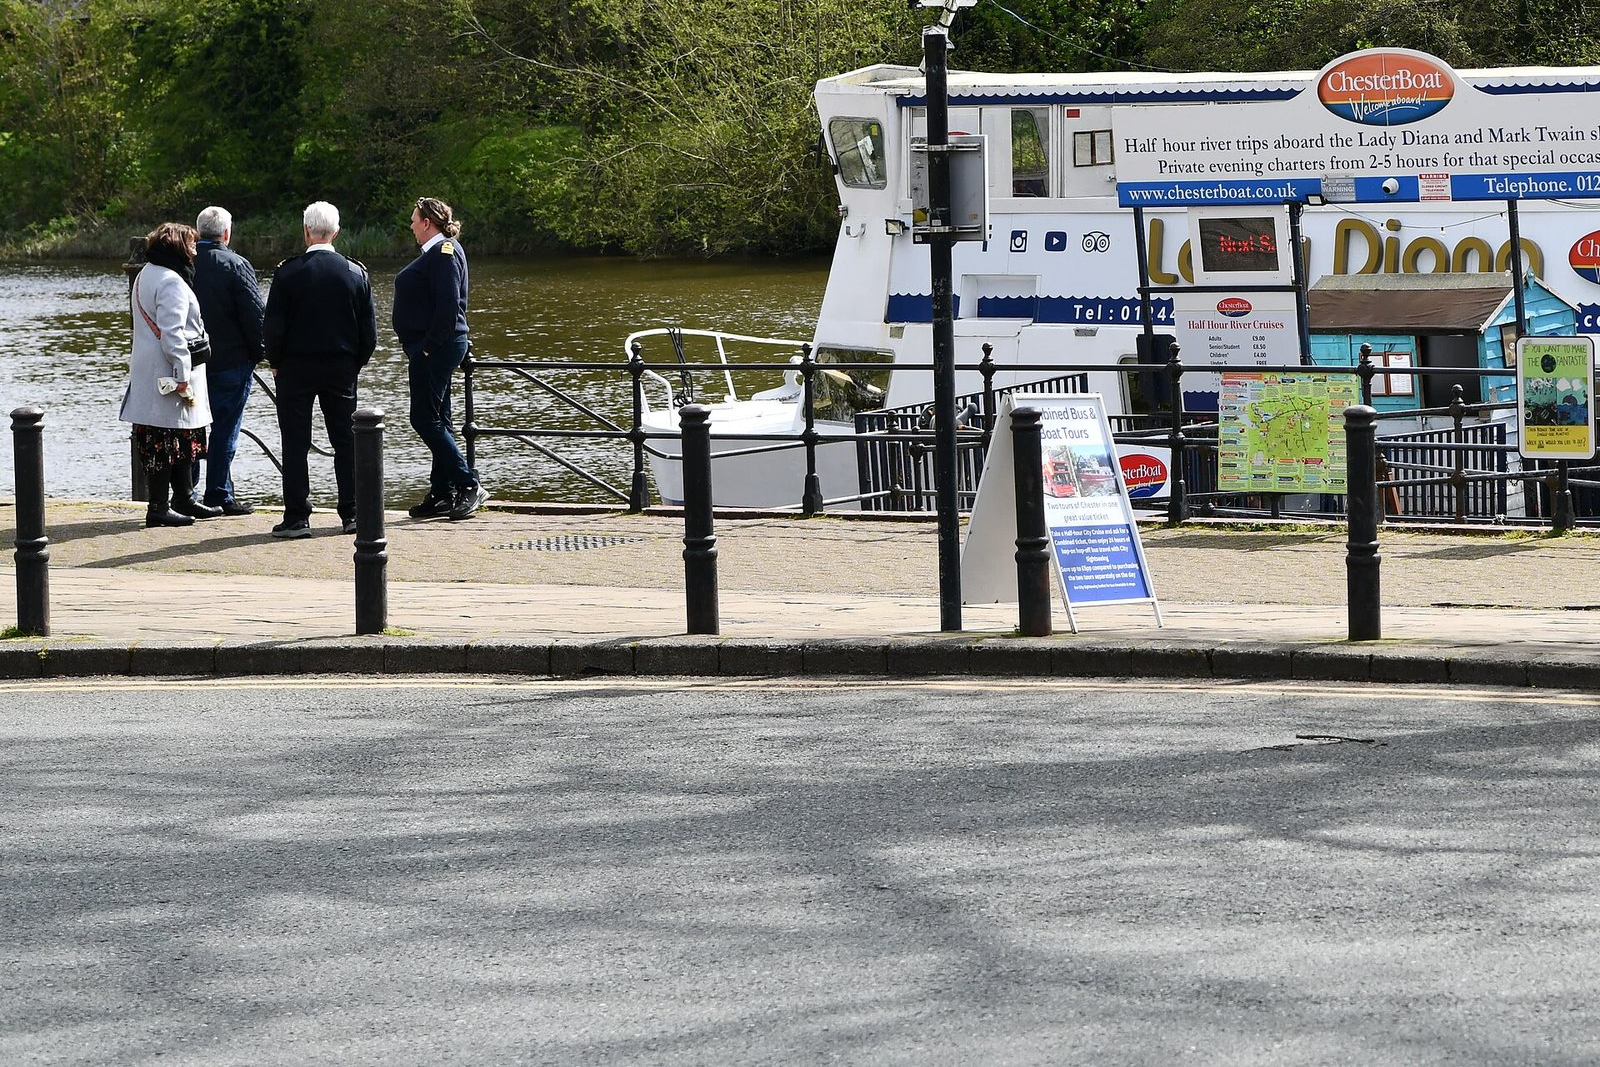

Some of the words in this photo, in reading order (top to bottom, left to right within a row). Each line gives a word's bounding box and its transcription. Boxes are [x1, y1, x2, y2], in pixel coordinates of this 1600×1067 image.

[1327, 69, 1443, 92] ChesterBoat
[1349, 93, 1390, 121] Welcome
[1391, 91, 1428, 107] aboard!
[1124, 137, 1157, 153] Half
[1162, 137, 1196, 153] hour
[1200, 136, 1232, 152] river
[1236, 135, 1269, 155] trips
[1274, 134, 1325, 151] aboard
[1329, 133, 1353, 148] the
[1358, 132, 1397, 151] Lady
[1401, 130, 1449, 146] Diana
[1454, 128, 1482, 144] and
[1488, 127, 1531, 143] Mark
[1535, 125, 1586, 142] Twain
[1158, 159, 1205, 174] Private
[1209, 158, 1264, 177] evening
[1268, 156, 1326, 172] charters
[1329, 155, 1364, 170] from
[1369, 155, 1392, 169] 2-5
[1396, 152, 1439, 168] hours
[1443, 152, 1464, 167] for
[1469, 151, 1498, 166] that
[1502, 150, 1554, 170] special
[1129, 181, 1297, 201] www.chesterboat.co.uk
[1484, 177, 1573, 198] Telephone.
[1188, 320, 1206, 330] Half
[1207, 320, 1229, 329] Hour
[1230, 320, 1252, 329] River
[1253, 320, 1284, 329] Cruises
[1544, 345, 1560, 353] WANT
[1528, 356, 1540, 366] THE
[1556, 355, 1587, 366] FANTASTIC
[1041, 407, 1069, 420] bined
[1070, 407, 1088, 420] Bus
[1089, 407, 1096, 420] &
[1041, 428, 1062, 440] Boat
[1062, 427, 1089, 439] Tours
[1122, 464, 1161, 480] sterBoat
